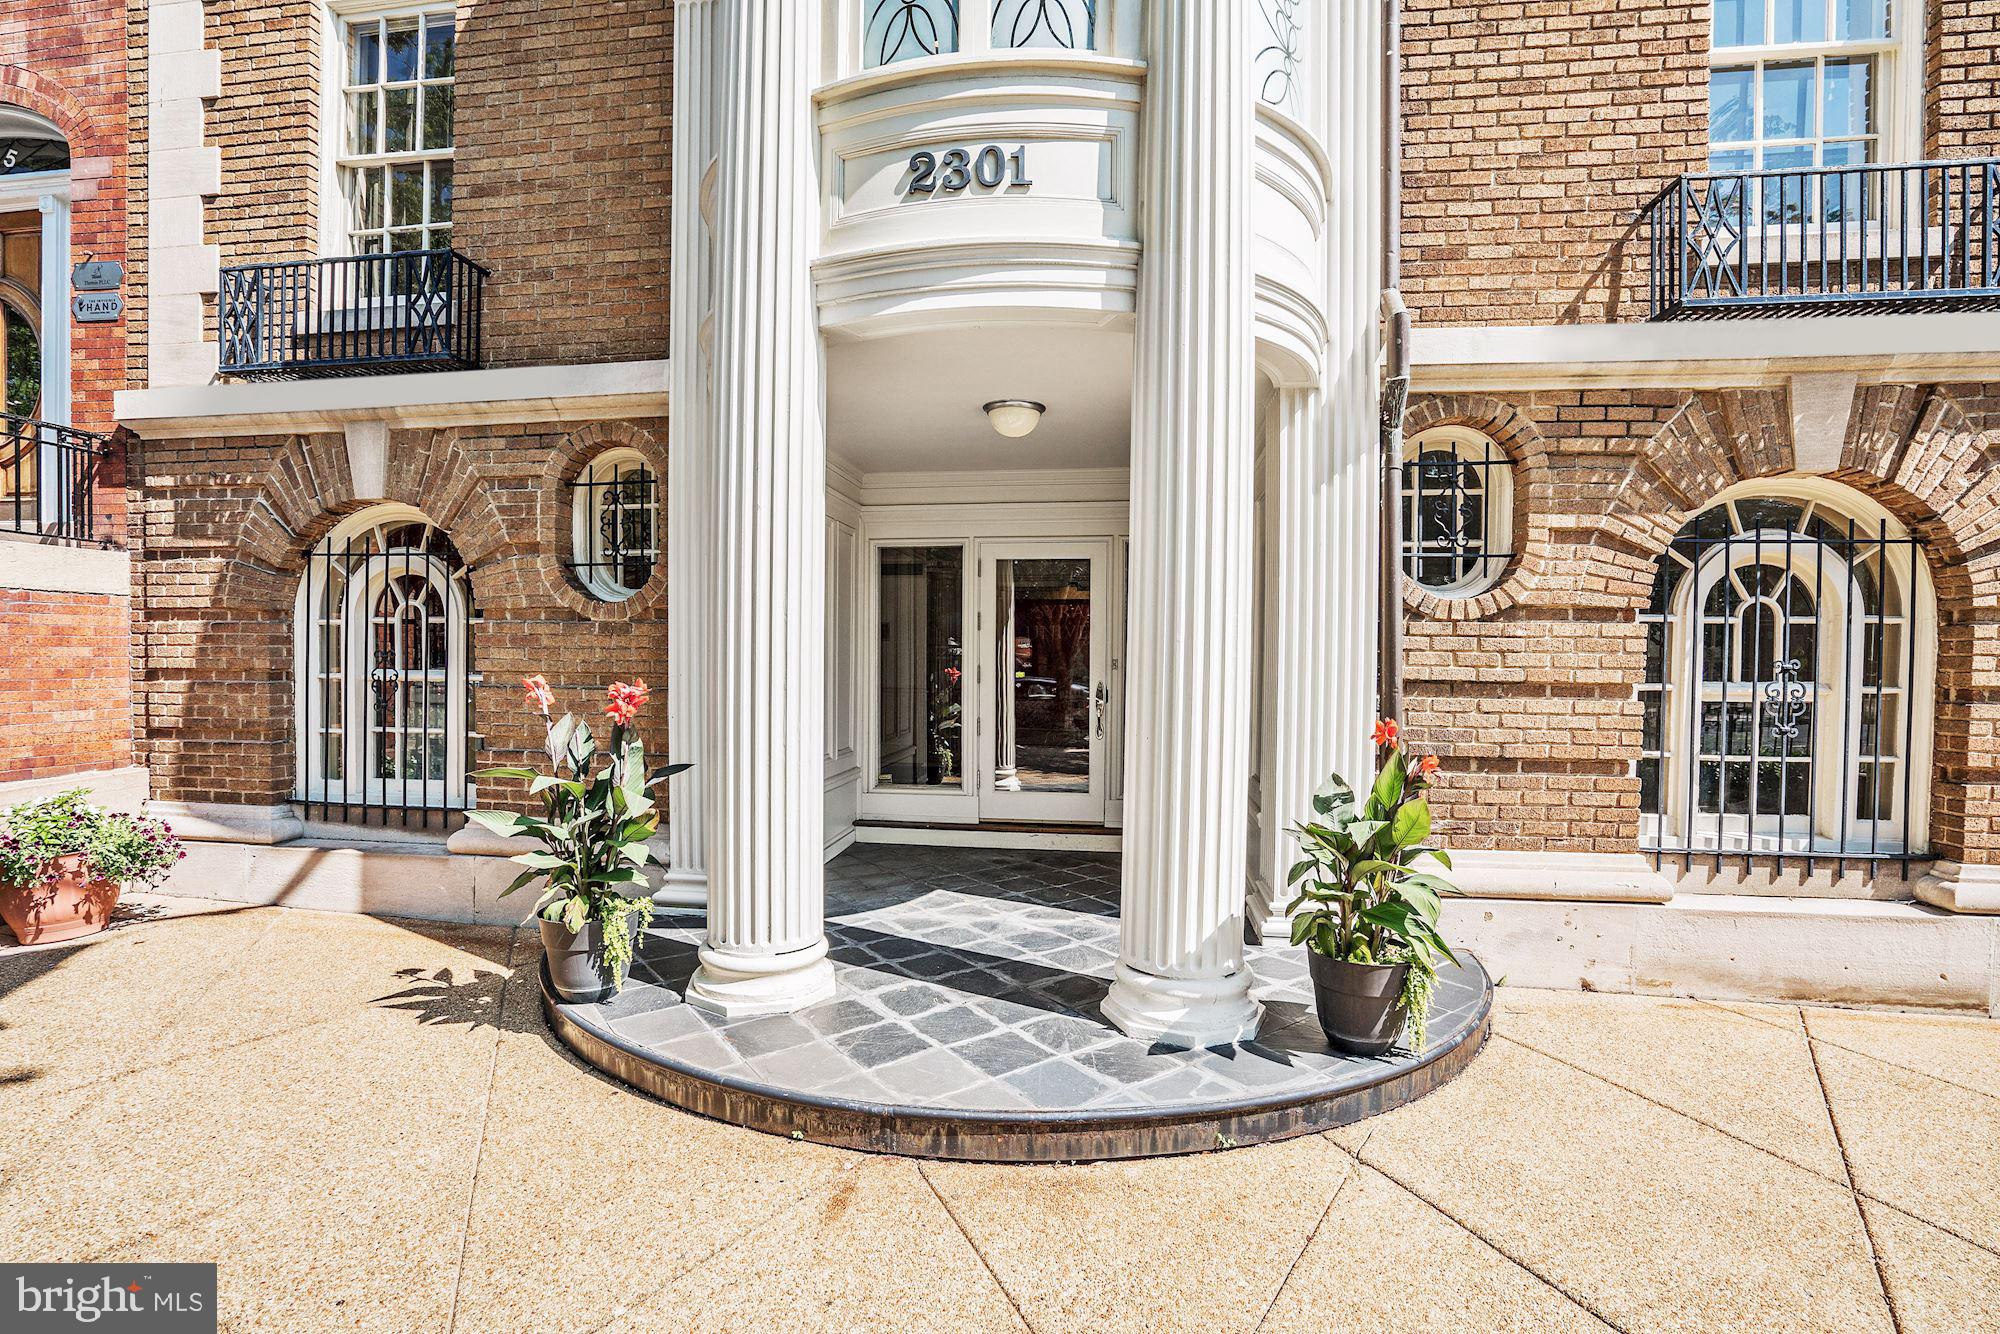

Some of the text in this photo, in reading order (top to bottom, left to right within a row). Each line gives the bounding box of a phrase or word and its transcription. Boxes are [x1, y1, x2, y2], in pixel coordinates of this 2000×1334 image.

[3, 148, 18, 167] 5
[909, 145, 1033, 194] 2301
[86, 302, 118, 311] HAND
